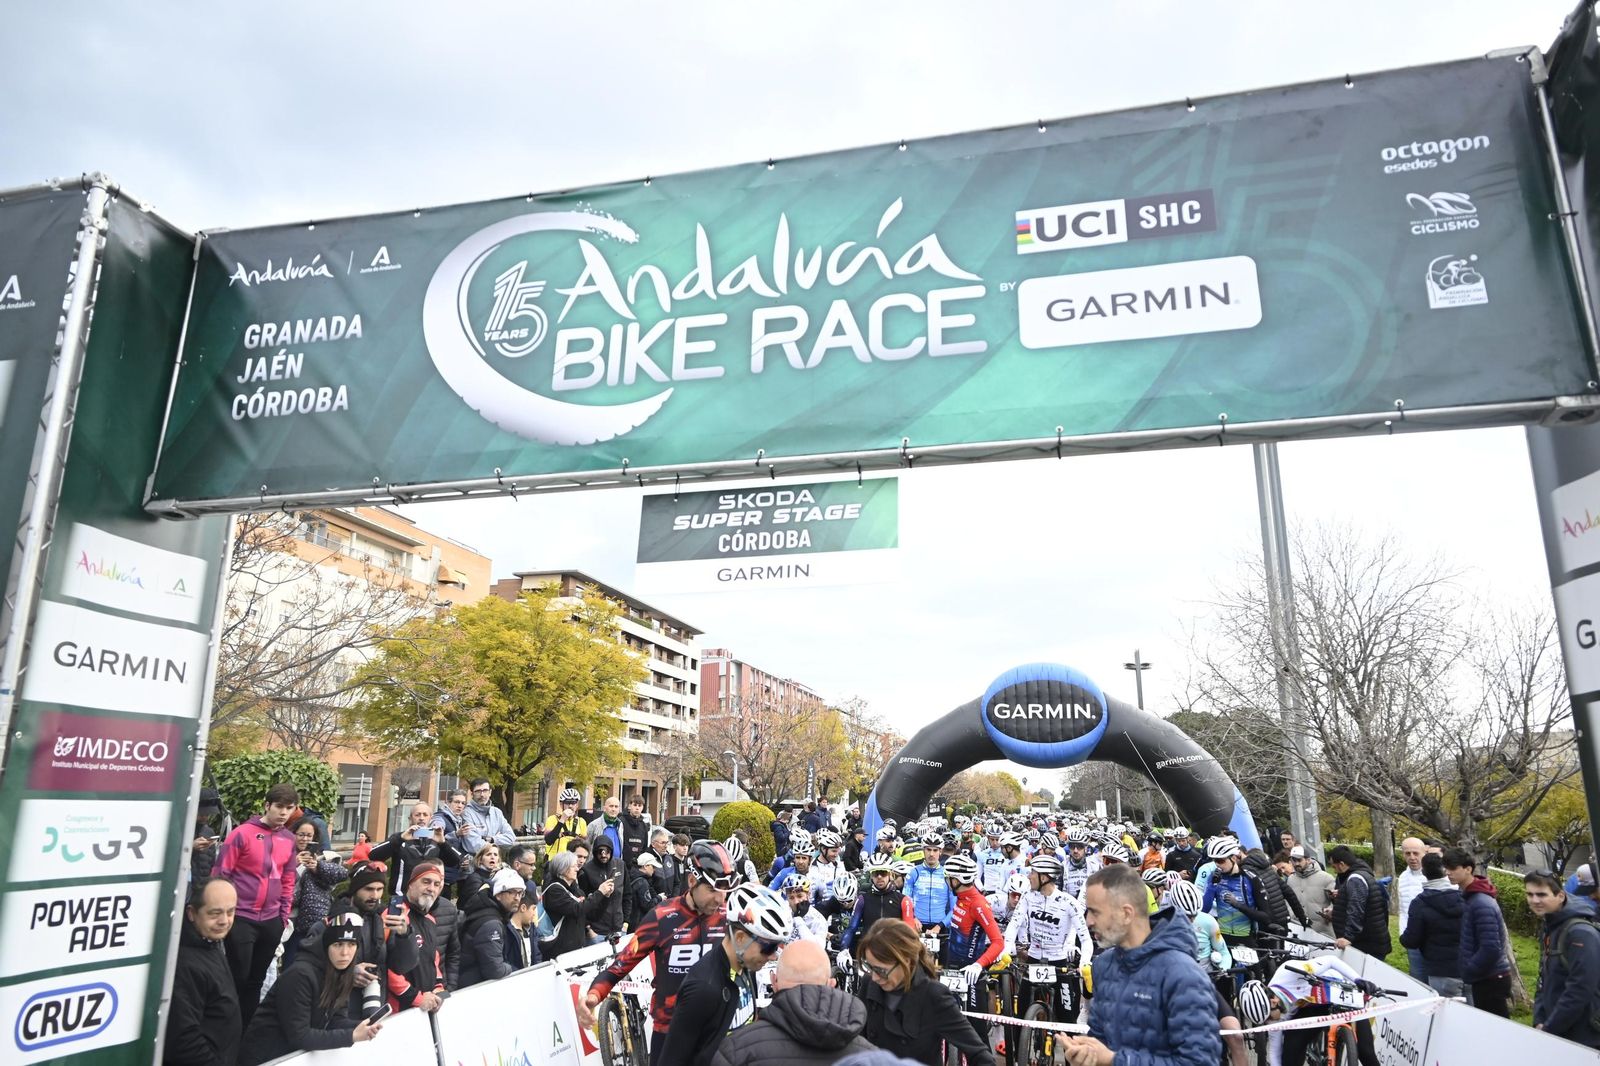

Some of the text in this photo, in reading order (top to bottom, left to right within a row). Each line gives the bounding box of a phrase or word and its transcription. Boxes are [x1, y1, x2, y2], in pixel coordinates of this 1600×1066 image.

[1381, 135, 1490, 163] octagon
[1384, 158, 1438, 174] esedos
[1035, 199, 1201, 242] UCI SHC
[1411, 219, 1480, 235] CICLISMO
[228, 253, 335, 287] Andalucía
[555, 196, 984, 324] Andalucía
[484, 260, 549, 358] 15
[999, 281, 1232, 323] BY GARMIN
[244, 313, 363, 350] GRANADA
[484, 328, 529, 342] YEARS
[551, 285, 988, 392] BIKE RACE
[236, 350, 304, 384] JAÉN
[231, 383, 349, 421] CÓRDOBA
[672, 503, 862, 531] SUPER STAGE
[718, 528, 812, 553] CÓRDOBA
[76, 551, 145, 589] Andalucía
[717, 563, 810, 582] GARMIN
[53, 641, 187, 684] GARMIN
[76, 736, 169, 762] IMDECO
[898, 756, 942, 769] garmin.com
[1155, 754, 1204, 770] garmin.com
[51, 760, 73, 768] Instituto
[73, 761, 100, 771] Municipal
[108, 763, 137, 772] Deportes
[138, 764, 165, 772] Córdoba
[30, 895, 132, 930] POWER
[1030, 910, 1061, 926] KTM
[68, 922, 129, 953] ADE
[968, 925, 981, 959] MANITOU
[1035, 967, 1050, 981] 6-2
[1060, 982, 1072, 1011] KTM
[22, 992, 106, 1041] CRUZ
[1381, 1017, 1419, 1066] Diputación
